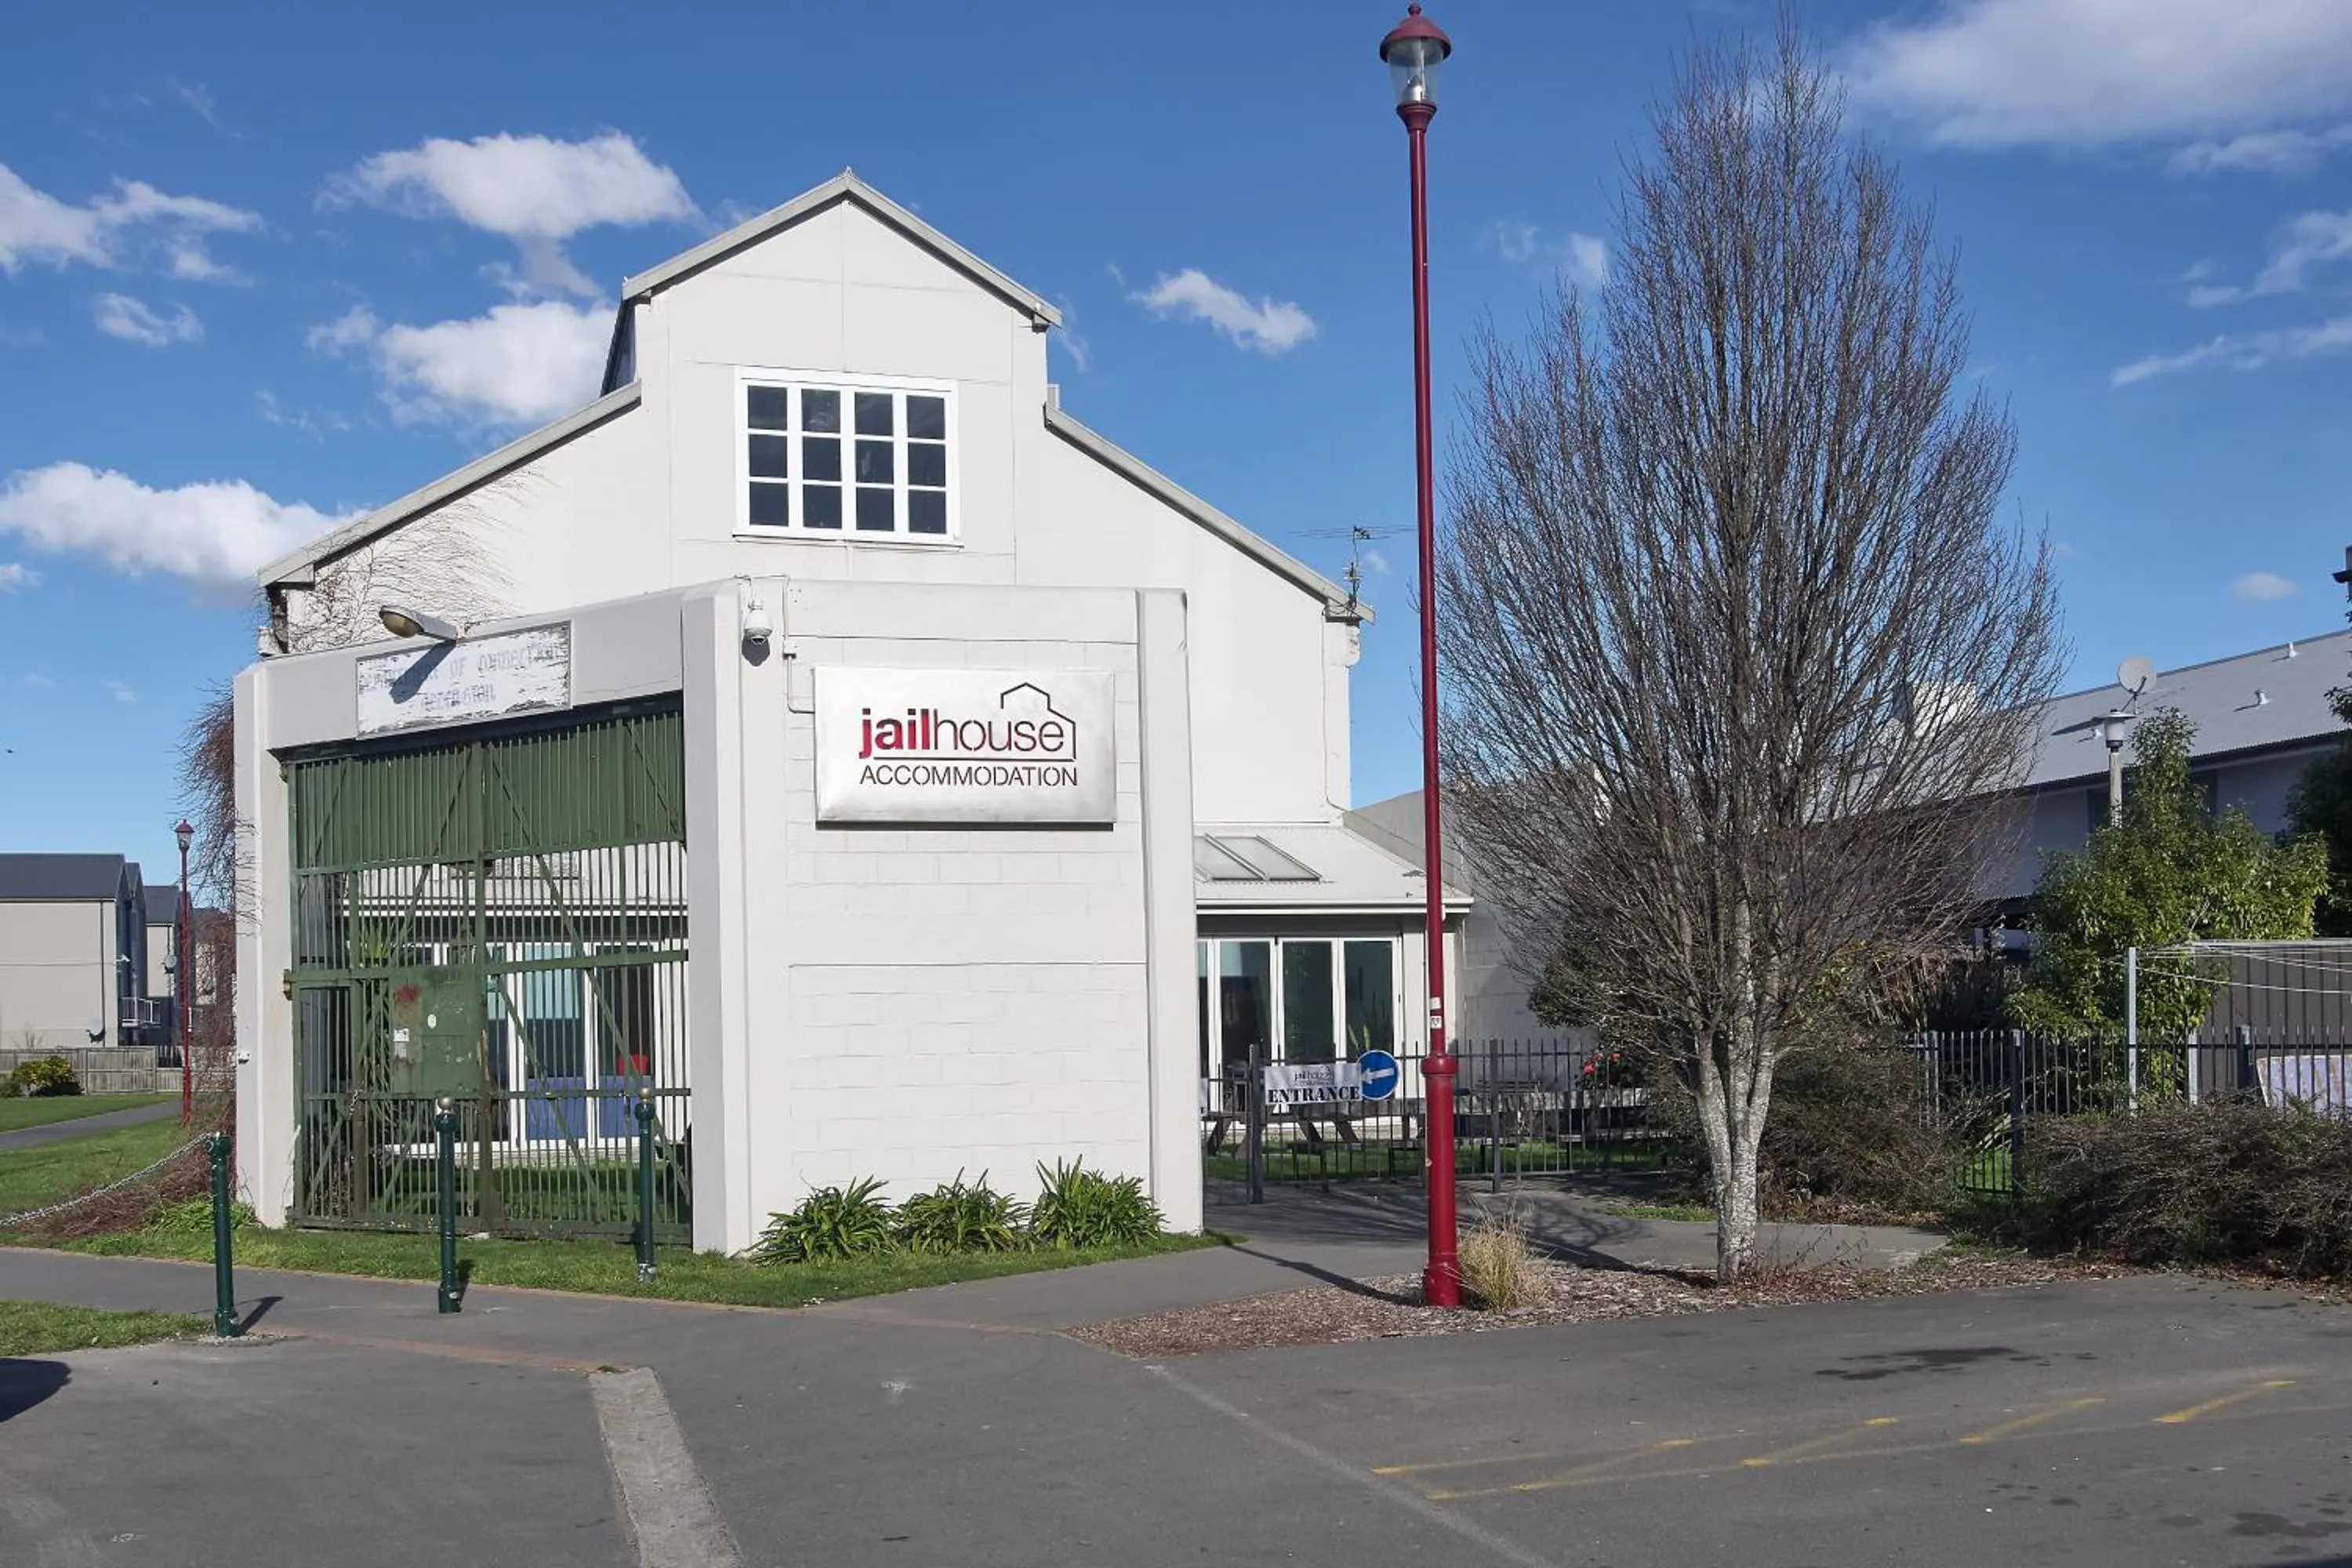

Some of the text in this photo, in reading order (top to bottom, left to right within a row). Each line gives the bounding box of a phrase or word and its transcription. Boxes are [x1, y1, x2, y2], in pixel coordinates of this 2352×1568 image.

[858, 708, 1065, 759] jailhouse
[859, 764, 1078, 786] ACCOMMODATION
[1268, 1086, 1359, 1103] ENTRANCE
